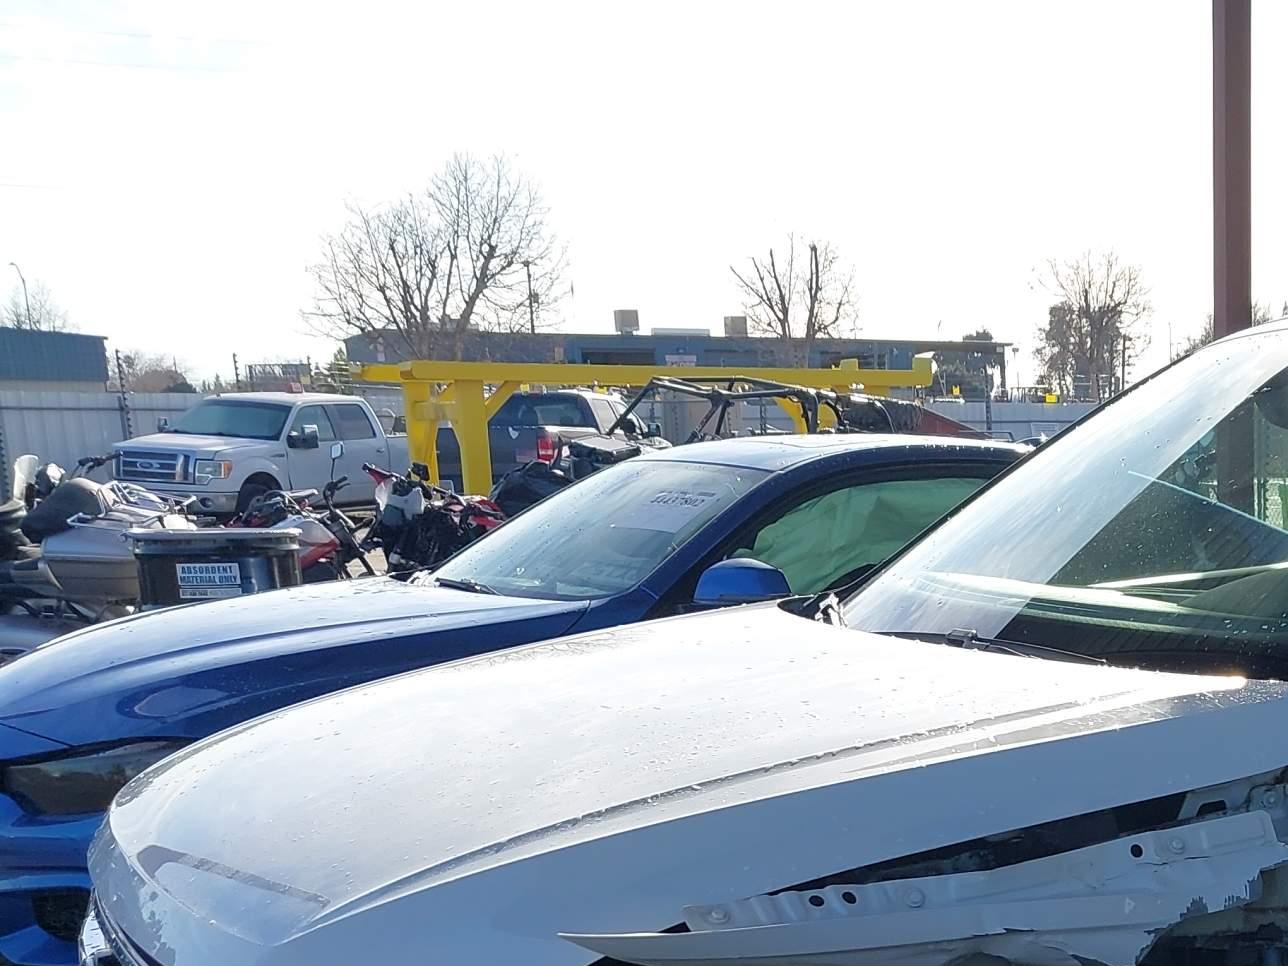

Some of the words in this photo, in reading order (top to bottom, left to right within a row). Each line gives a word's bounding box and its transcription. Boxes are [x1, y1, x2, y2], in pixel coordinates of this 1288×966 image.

[181, 566, 233, 575] ABSORBENT
[179, 575, 217, 584] MATERIAL
[218, 575, 238, 584] ONLY
